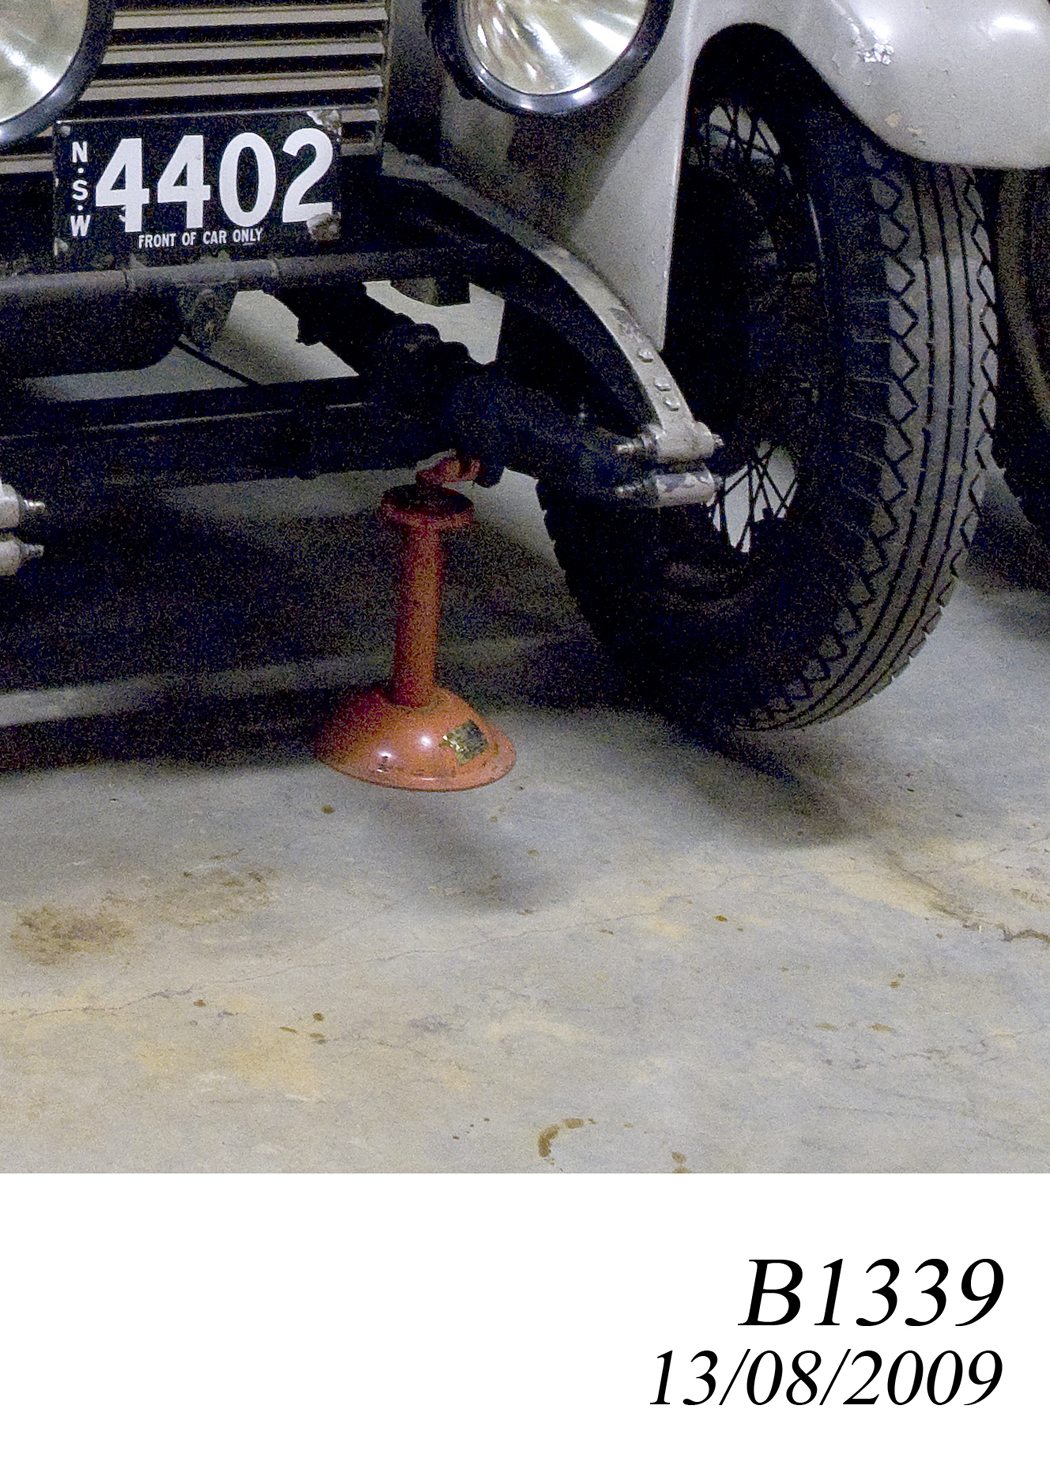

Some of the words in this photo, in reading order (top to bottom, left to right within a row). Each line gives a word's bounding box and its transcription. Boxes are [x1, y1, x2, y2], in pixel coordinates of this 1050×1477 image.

[95, 128, 334, 233] 4402
[138, 233, 176, 249] FRONT
[181, 231, 197, 246] OF
[202, 230, 227, 245] CAR
[233, 228, 263, 243] ONLY
